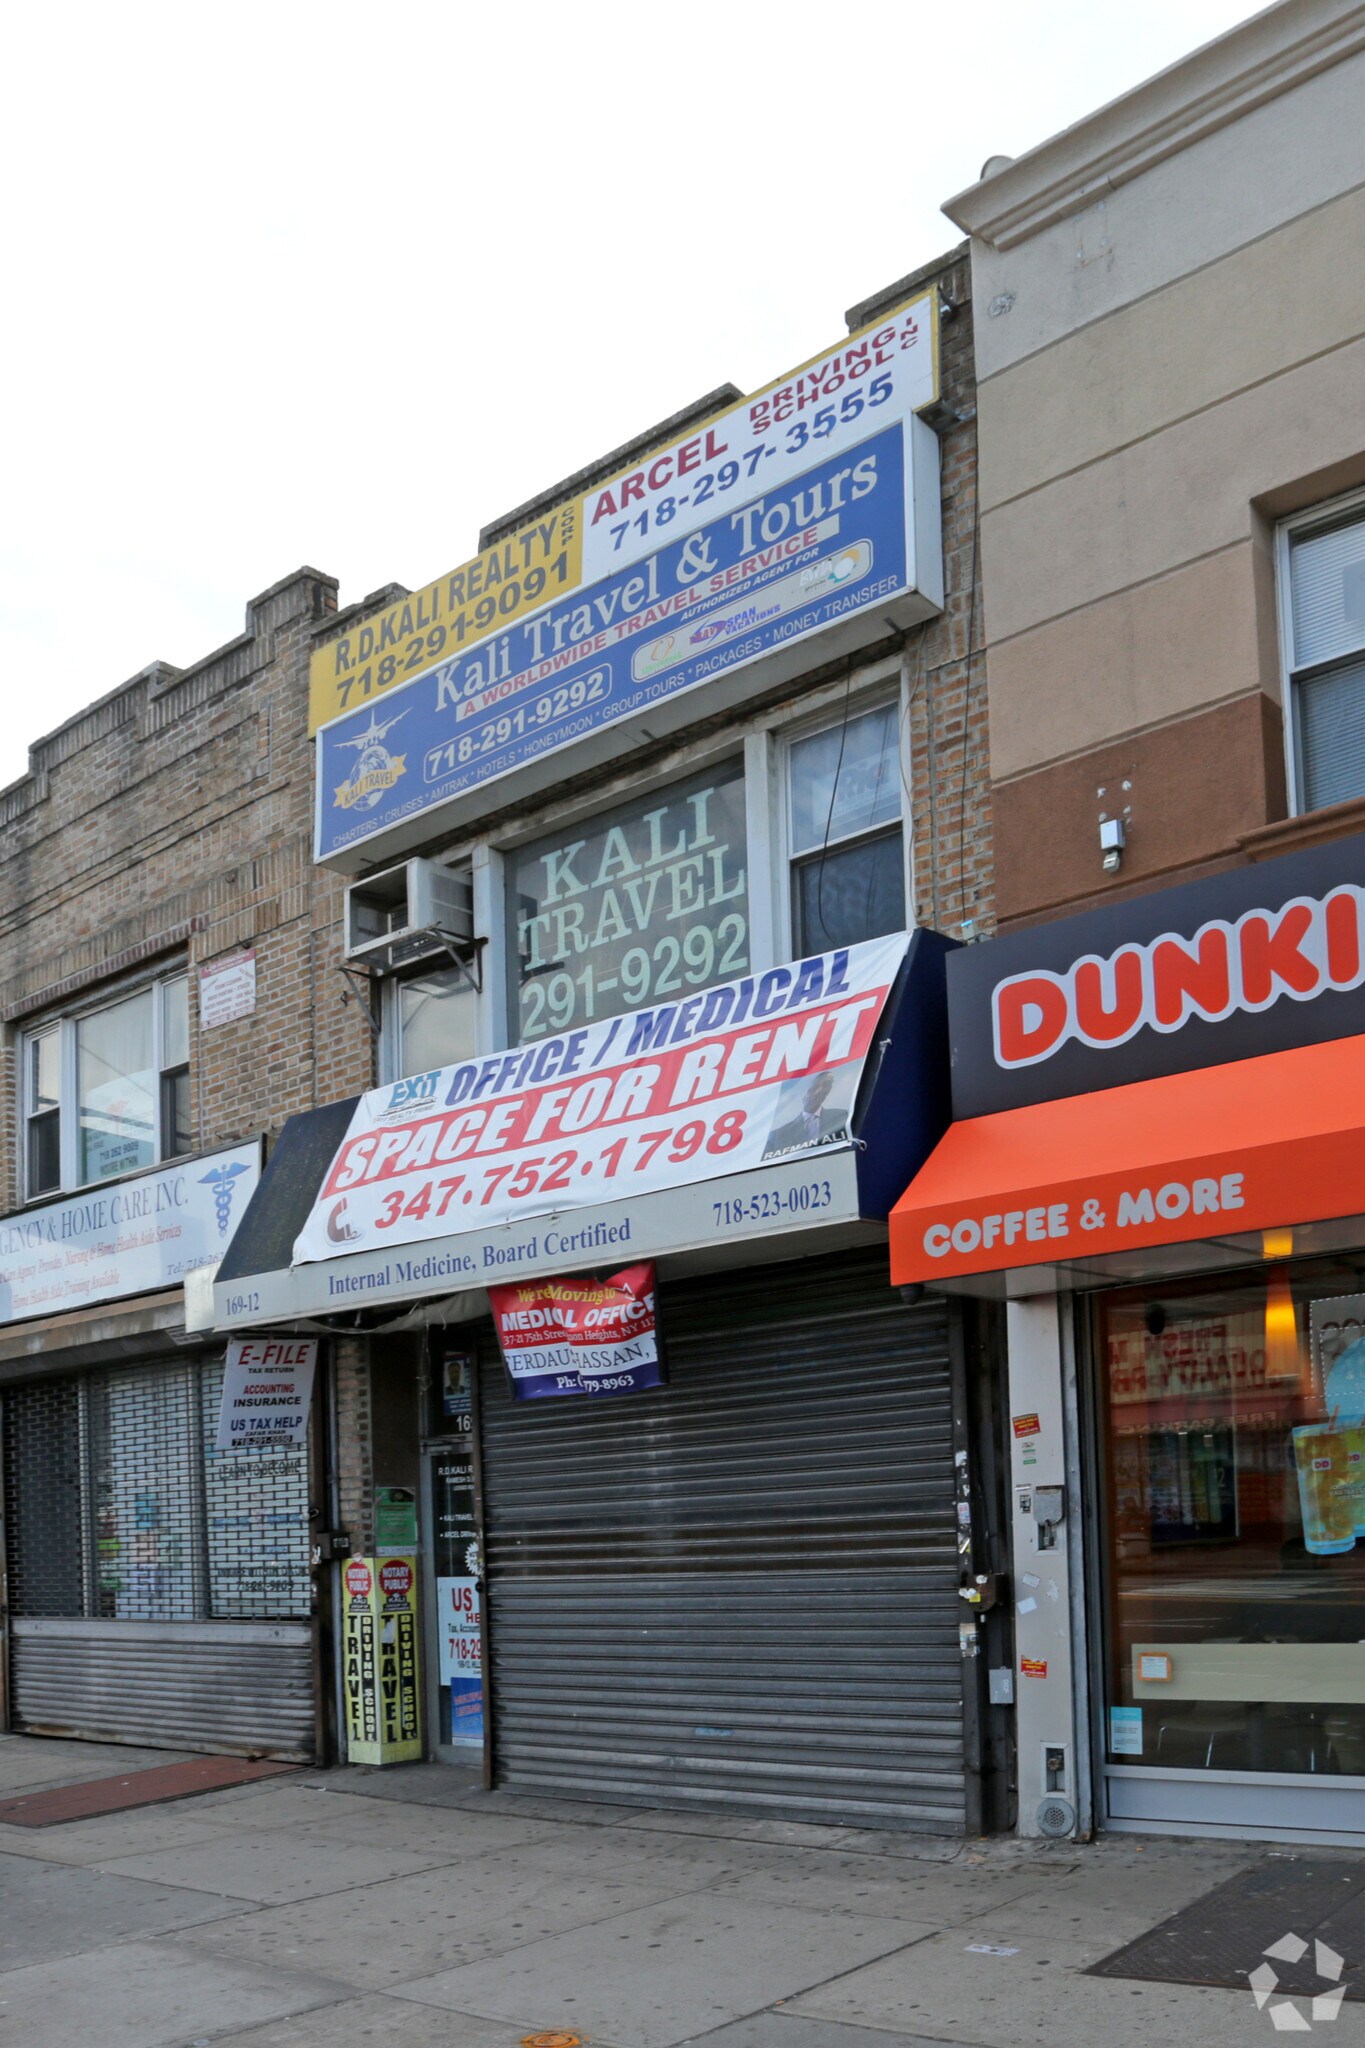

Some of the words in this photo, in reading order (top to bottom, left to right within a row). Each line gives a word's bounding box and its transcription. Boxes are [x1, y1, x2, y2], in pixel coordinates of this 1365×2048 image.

[900, 317, 919, 351] INC
[750, 325, 897, 422] DRIVING
[752, 350, 895, 436] SCHOOL
[591, 429, 728, 527] ARCEL
[560, 506, 575, 548] CORP
[435, 636, 512, 713] Kali
[524, 555, 661, 663] Travel
[676, 531, 718, 584] &
[731, 454, 878, 556] Tours
[448, 515, 558, 612] REALTY
[680, 580, 751, 622] AUTHORIZED
[752, 561, 793, 586] AGENT
[795, 547, 819, 565] FOR
[337, 551, 568, 709] 718-291-9091
[462, 701, 476, 717] A
[481, 632, 607, 707] WORLDWIDE
[613, 587, 702, 639] TRAVEL
[710, 526, 818, 592] SERVICE
[332, 818, 378, 848] CHARTERS
[384, 795, 424, 822] CRUISES
[430, 774, 469, 802] AMTRAK
[476, 751, 516, 778] HOTELS
[523, 714, 593, 756] HONEYMOON
[602, 690, 643, 720] GROUP
[643, 672, 685, 698] TOURS
[695, 636, 762, 678] PACKAGES
[773, 609, 821, 642] MONEY
[824, 574, 898, 616] TRANSFER
[428, 671, 604, 777] 718-291-9292
[364, 770, 395, 789] TRAVEL
[540, 786, 716, 908] KALI
[518, 844, 745, 971] TRAVEL
[522, 913, 748, 1038] 291-9292
[445, 1030, 588, 1106] OFFICE
[625, 949, 849, 1058] MEDICAL
[334, 1100, 524, 1189] SPACE
[522, 1063, 661, 1143] FOR
[668, 995, 879, 1107] RENT
[821, 1130, 846, 1144] ALI
[47, 1216, 57, 1243] &
[61, 1200, 107, 1239] HOME
[110, 1187, 152, 1225] CARE
[155, 1176, 189, 1213] INC.
[712, 1181, 832, 1227] 718-523-0023
[923, 1203, 1070, 1258] COFFEE
[1079, 1198, 1106, 1231] &
[1117, 1172, 1245, 1227] MORE
[328, 1265, 390, 1295] Internal
[396, 1253, 477, 1283] Medicine,
[482, 1236, 538, 1267] Board
[543, 1217, 631, 1255] Certified
[226, 1292, 260, 1316] 169-12
[547, 1285, 603, 1304] Moving
[604, 1288, 616, 1299] to
[238, 1344, 311, 1366] E-FILE
[584, 1329, 620, 1342] Heights,
[621, 1323, 639, 1336] NY
[233, 1396, 302, 1408] INSURANCE
[243, 1383, 295, 1395] ACCOUNTING
[230, 1418, 246, 1432] US
[249, 1417, 272, 1430] TAX
[273, 1416, 303, 1429] HELP
[456, 1414, 473, 1432] 16
[348, 1580, 369, 1591] PUBLIC
[382, 1566, 409, 1578] NOTARY
[383, 1579, 409, 1590] PUBLIC
[451, 1587, 473, 1612] US
[362, 1616, 373, 1679] DRIVING
[400, 1615, 413, 1677] DRIVING
[347, 1615, 361, 1741] TRAVEL
[363, 1688, 376, 1741] SCHOOL
[403, 1686, 415, 1739] SCHOOL
